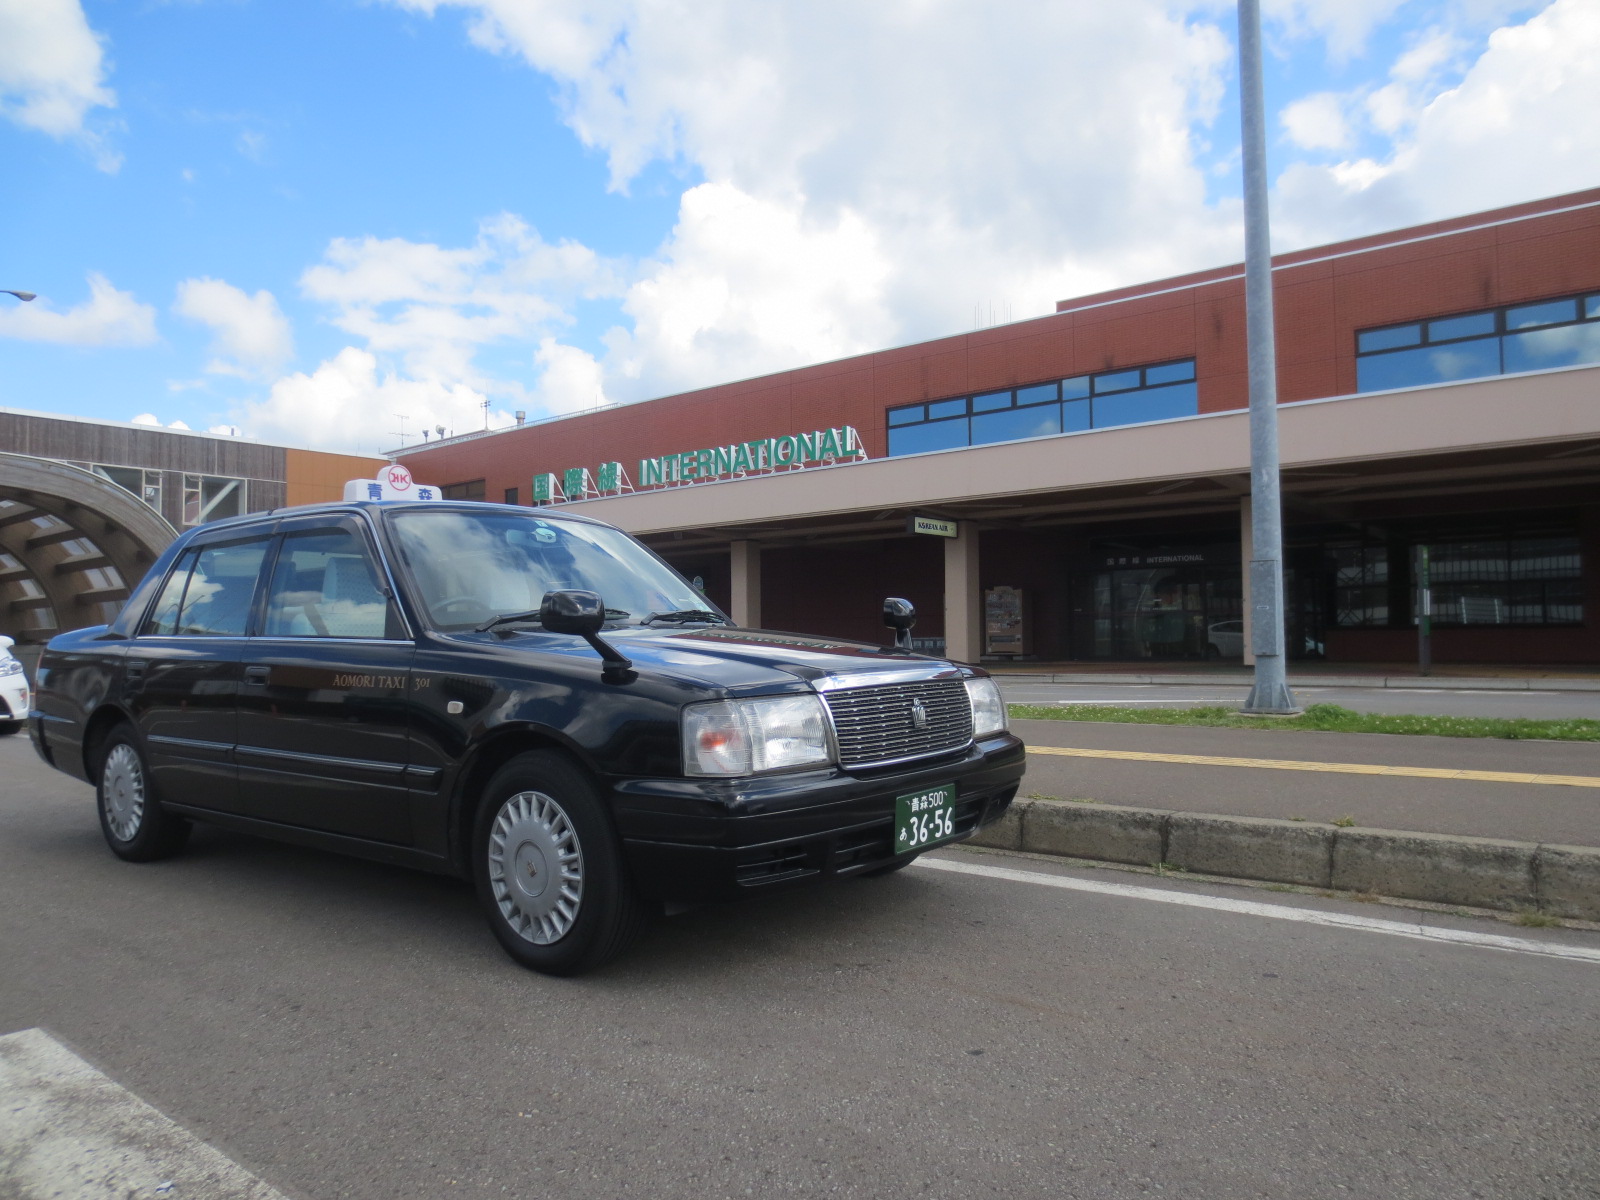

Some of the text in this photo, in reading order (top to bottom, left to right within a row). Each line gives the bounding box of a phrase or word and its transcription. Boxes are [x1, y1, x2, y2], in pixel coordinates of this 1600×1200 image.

[639, 426, 861, 486] INTERNATIONAL
[1146, 554, 1205, 564] INTERNATIONAL
[333, 674, 430, 691] AOMORI TAXI 301
